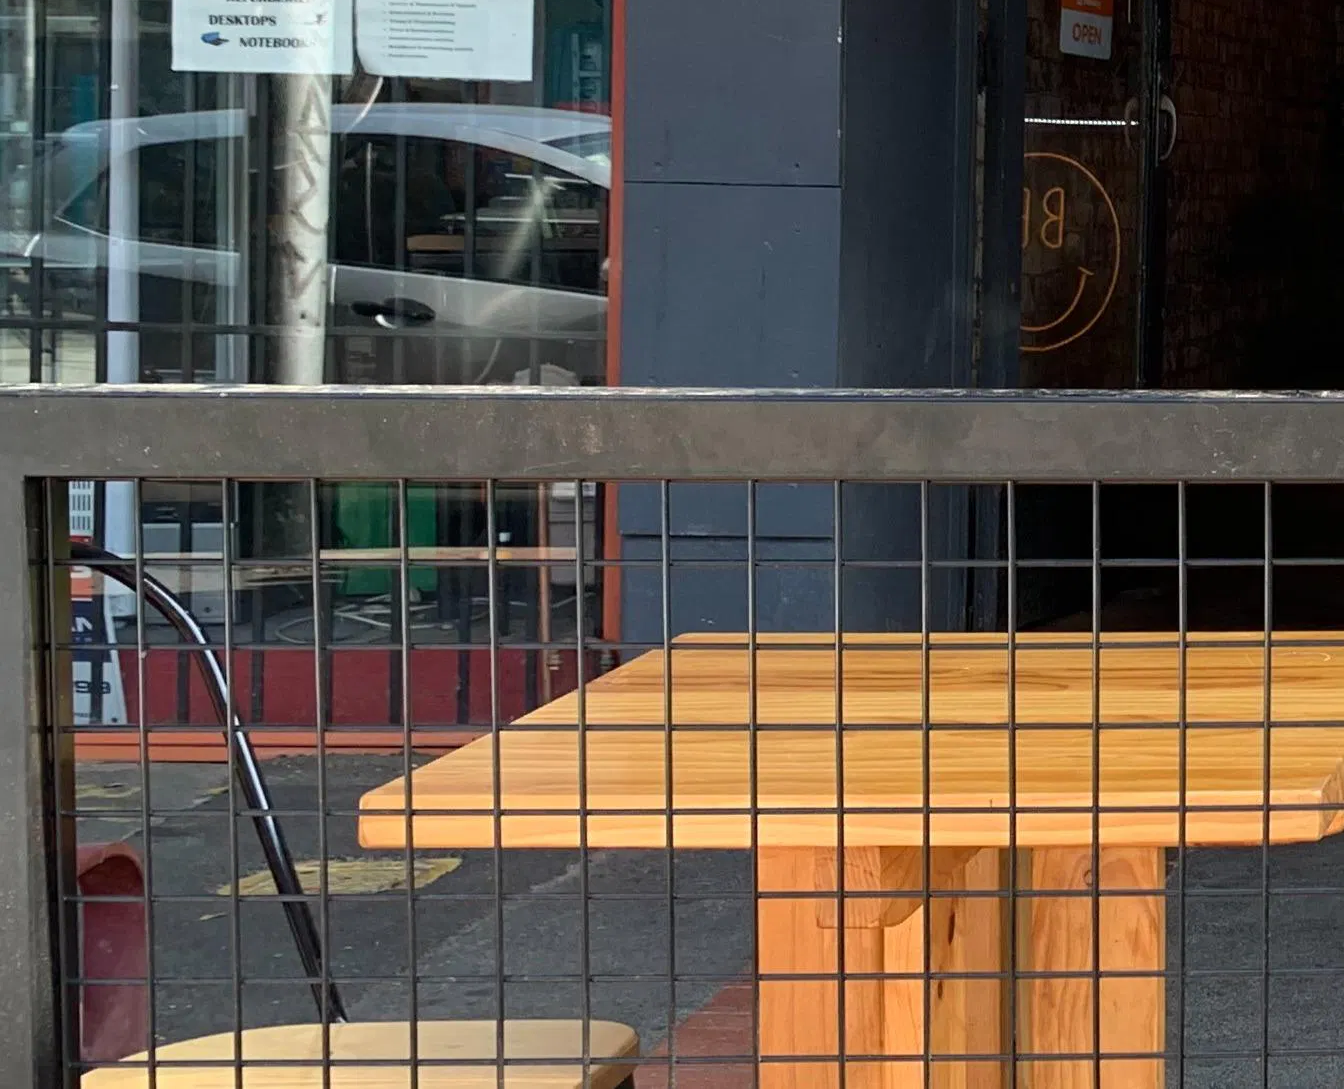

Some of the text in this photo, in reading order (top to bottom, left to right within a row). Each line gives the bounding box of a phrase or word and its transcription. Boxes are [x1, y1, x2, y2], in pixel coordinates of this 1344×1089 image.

[209, 14, 277, 26] DESKTOPS
[1072, 22, 1104, 45] OPEN
[239, 36, 308, 48] NOTEBOO
